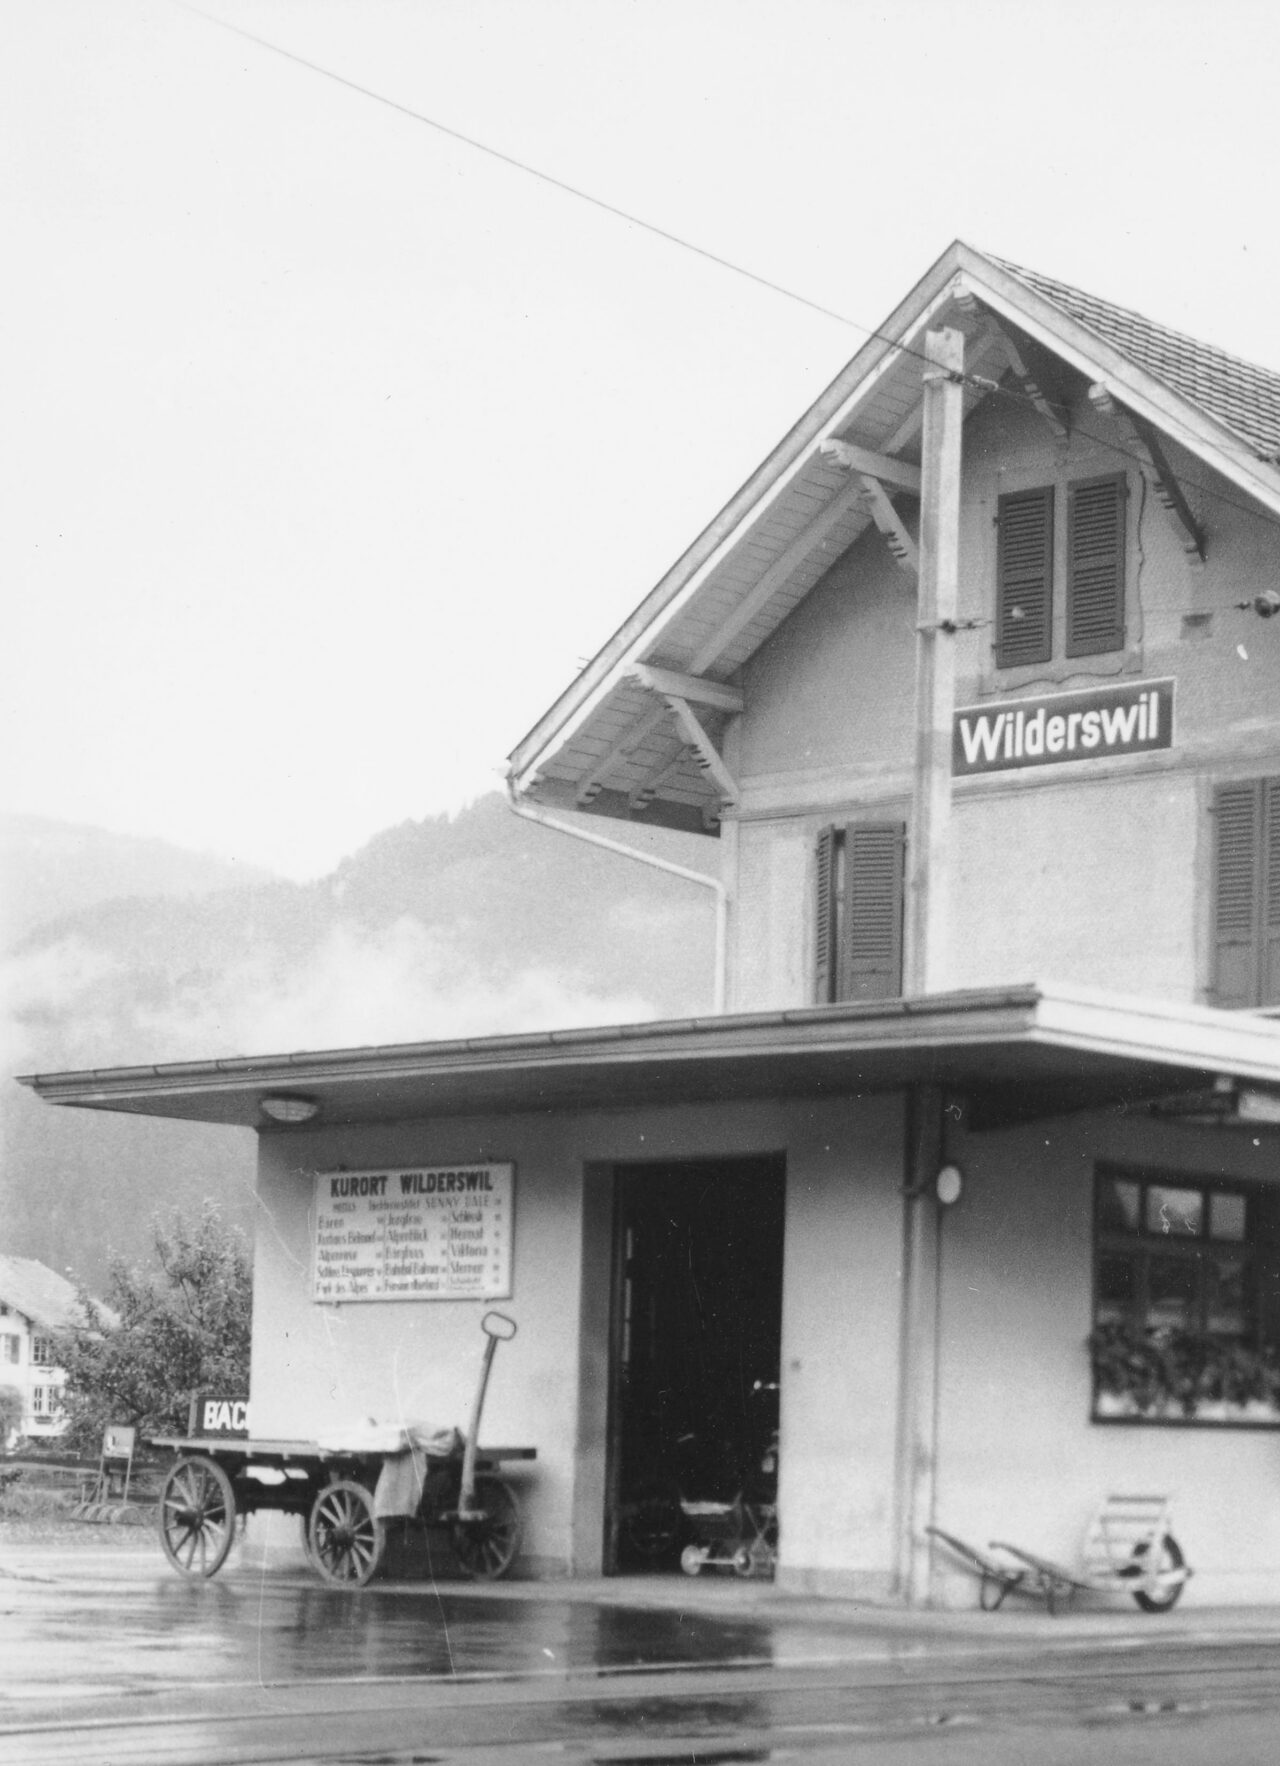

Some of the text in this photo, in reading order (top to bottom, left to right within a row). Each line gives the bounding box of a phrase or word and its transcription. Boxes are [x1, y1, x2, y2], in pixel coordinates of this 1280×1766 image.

[959, 691, 1159, 764] Wilderswil
[331, 1171, 493, 1198] KURORT WILDERSWIL
